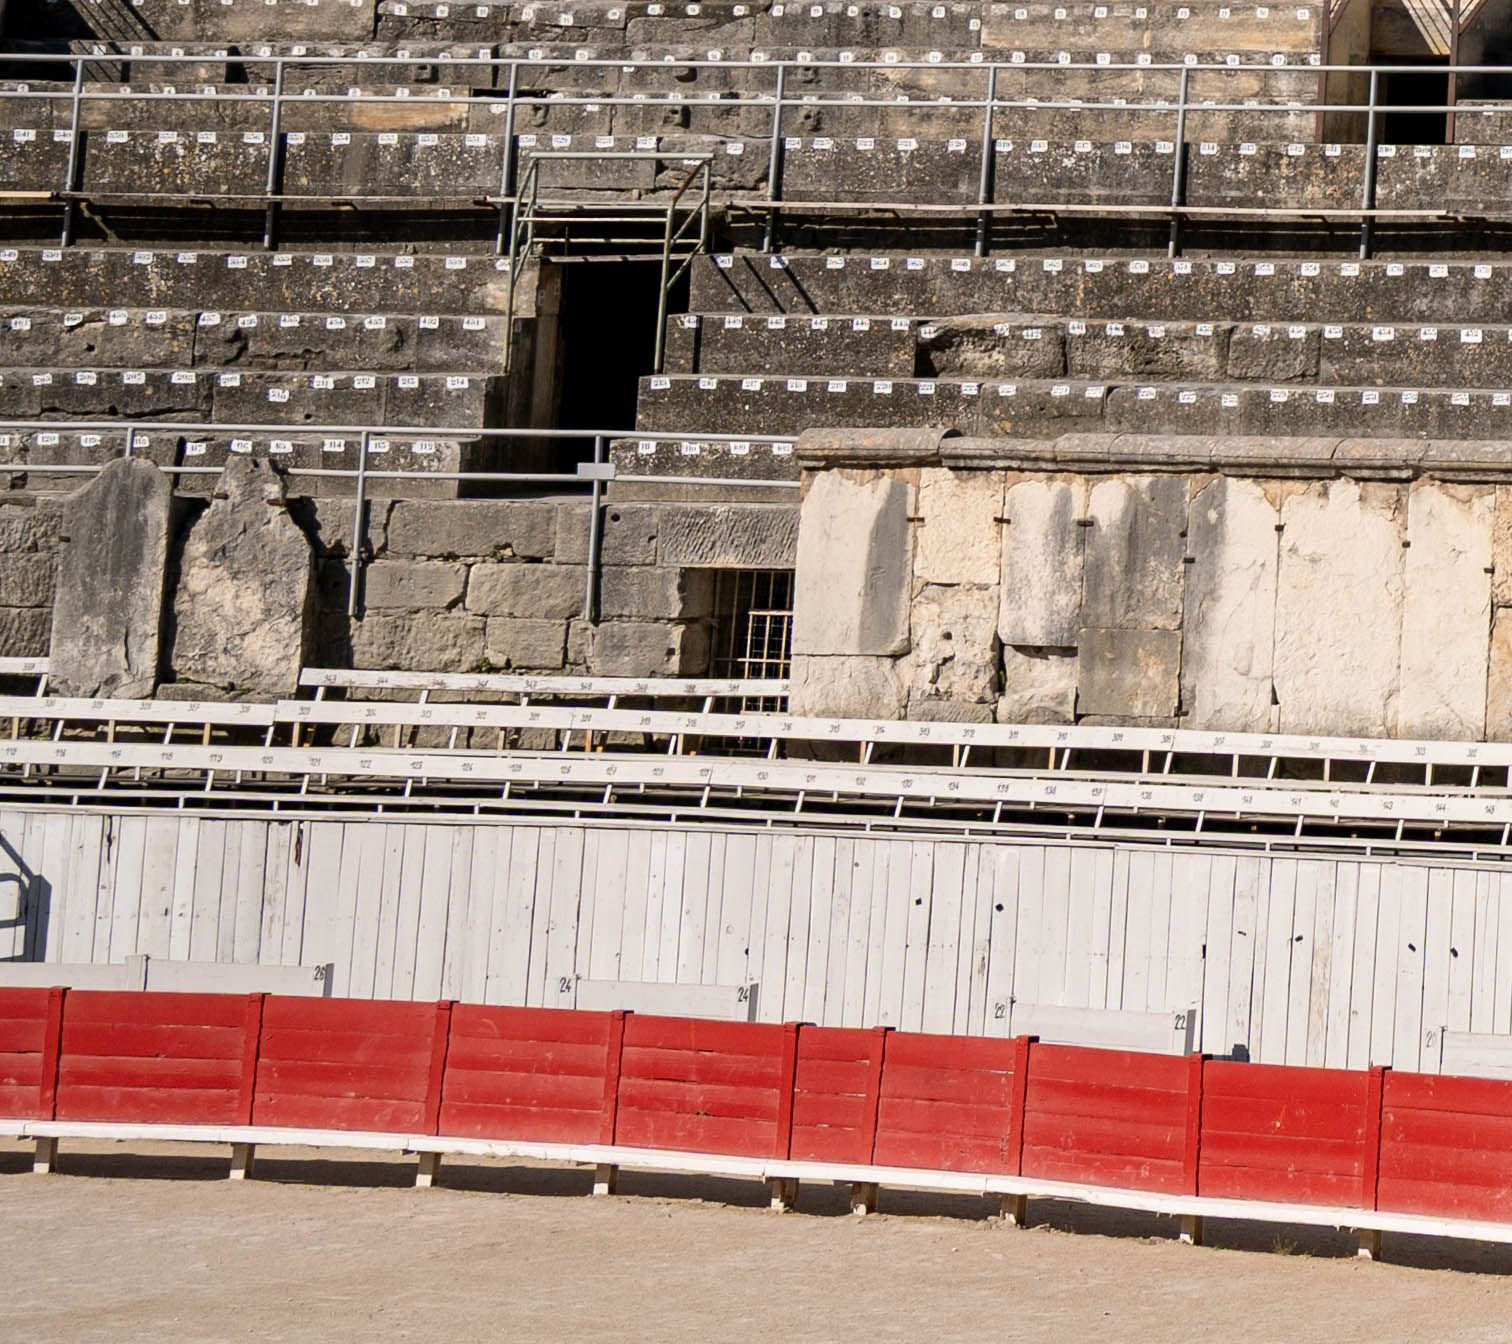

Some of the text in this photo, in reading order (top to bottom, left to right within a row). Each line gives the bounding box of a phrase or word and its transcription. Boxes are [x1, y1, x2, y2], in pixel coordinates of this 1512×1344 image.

[315, 966, 325, 981] 26
[560, 977, 571, 993] 24
[738, 987, 748, 1002] 24
[995, 1003, 1005, 1019] 22
[1175, 1015, 1186, 1030] 22
